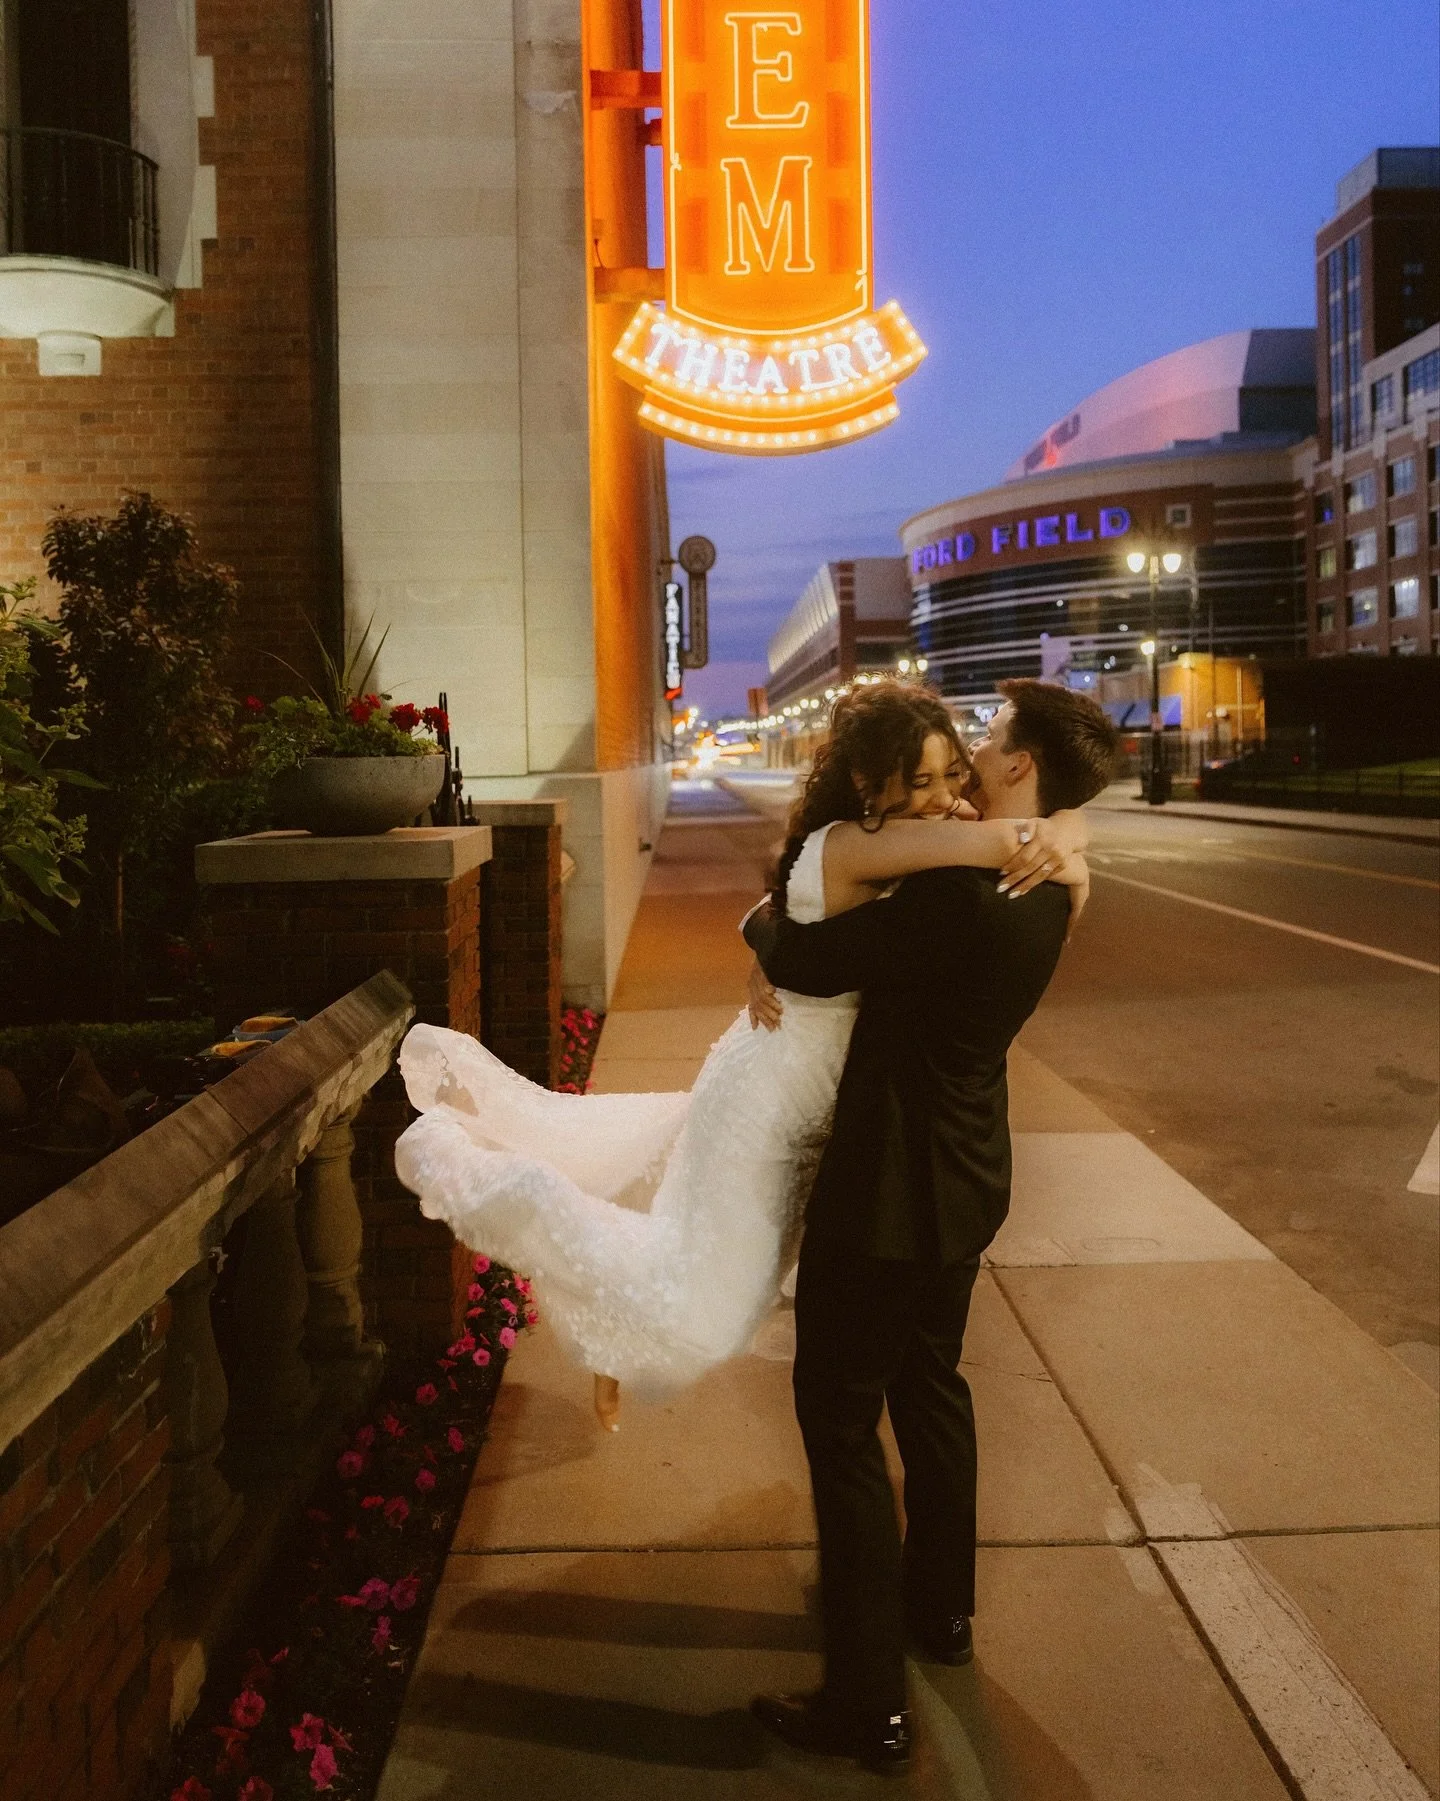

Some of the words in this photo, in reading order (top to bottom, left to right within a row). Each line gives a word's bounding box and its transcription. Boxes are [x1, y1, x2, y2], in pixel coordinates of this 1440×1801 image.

[644, 322, 892, 395] THEATRE
[912, 532, 975, 574] FORD
[992, 507, 1131, 554] FIELD
